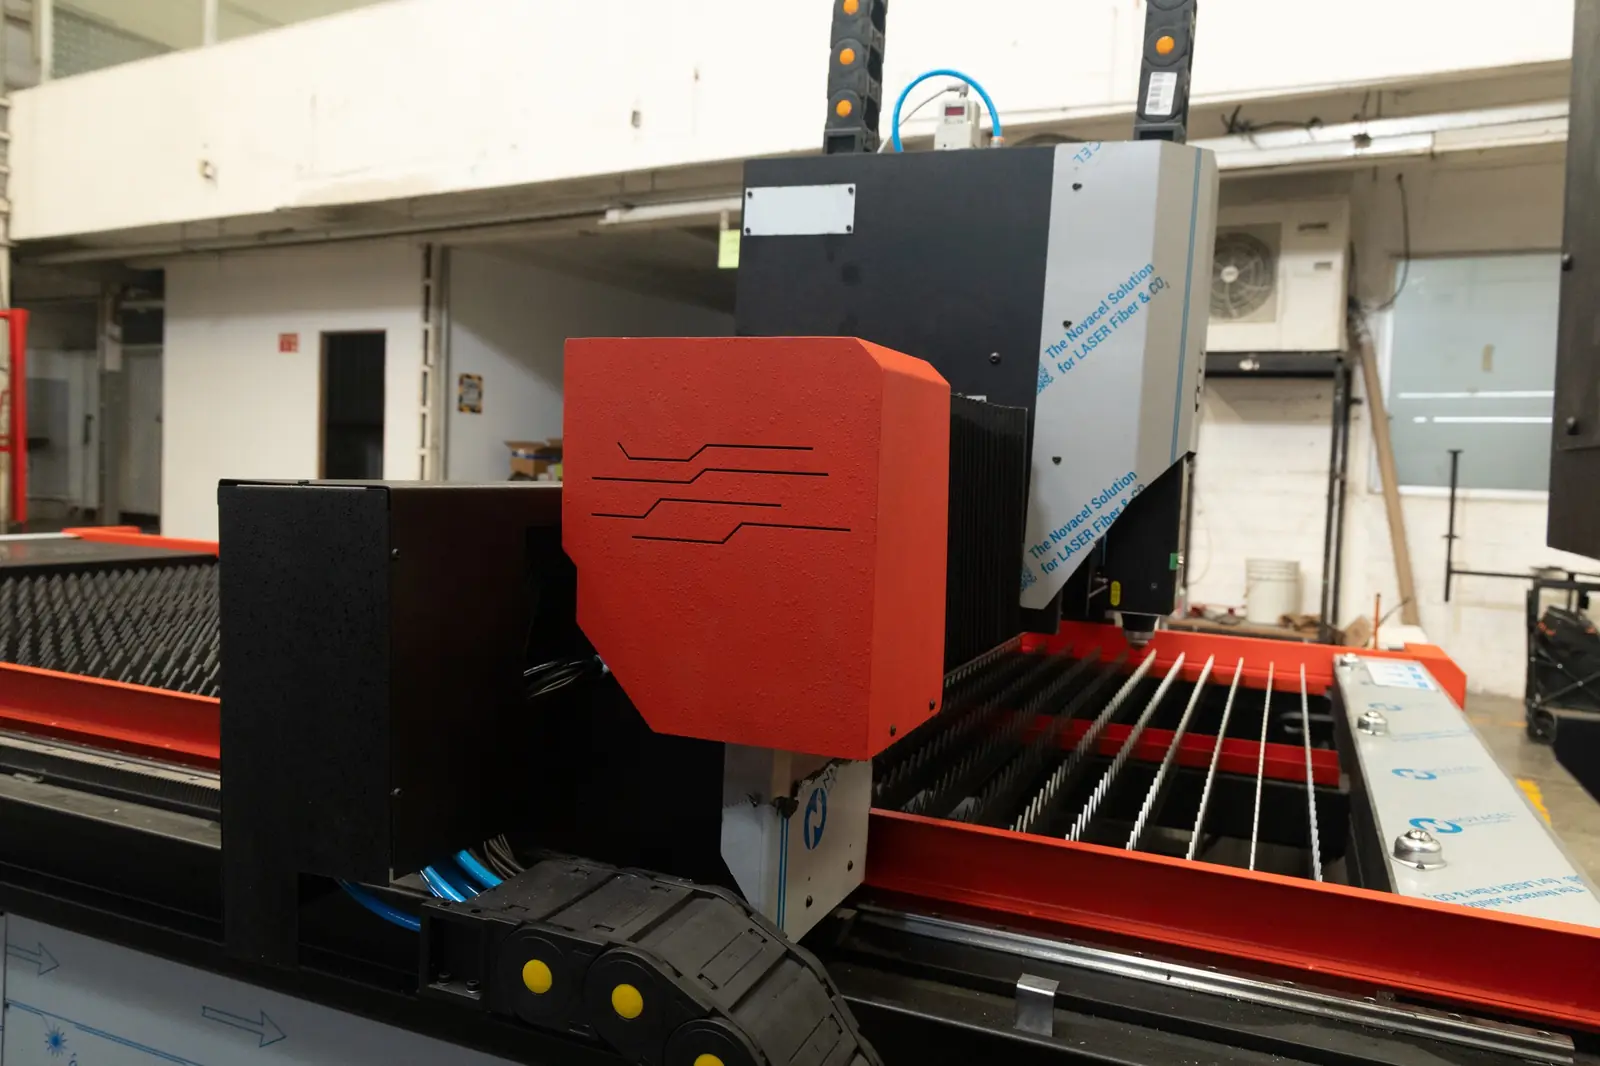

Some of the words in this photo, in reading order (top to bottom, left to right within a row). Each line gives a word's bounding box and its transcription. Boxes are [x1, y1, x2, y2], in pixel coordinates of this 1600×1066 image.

[1045, 339, 1068, 359] The
[1065, 300, 1110, 342] Novacel
[1107, 263, 1155, 305] Solution
[1057, 357, 1075, 374] for
[1074, 324, 1112, 360] LASER
[1109, 301, 1140, 329] Fiber
[1138, 291, 1151, 304] &
[1028, 541, 1052, 559] The
[1049, 504, 1093, 544] Novacel
[1091, 471, 1138, 510] Solution
[1040, 558, 1058, 575] for
[1057, 528, 1095, 562] LASER
[1092, 507, 1121, 533] Fiber
